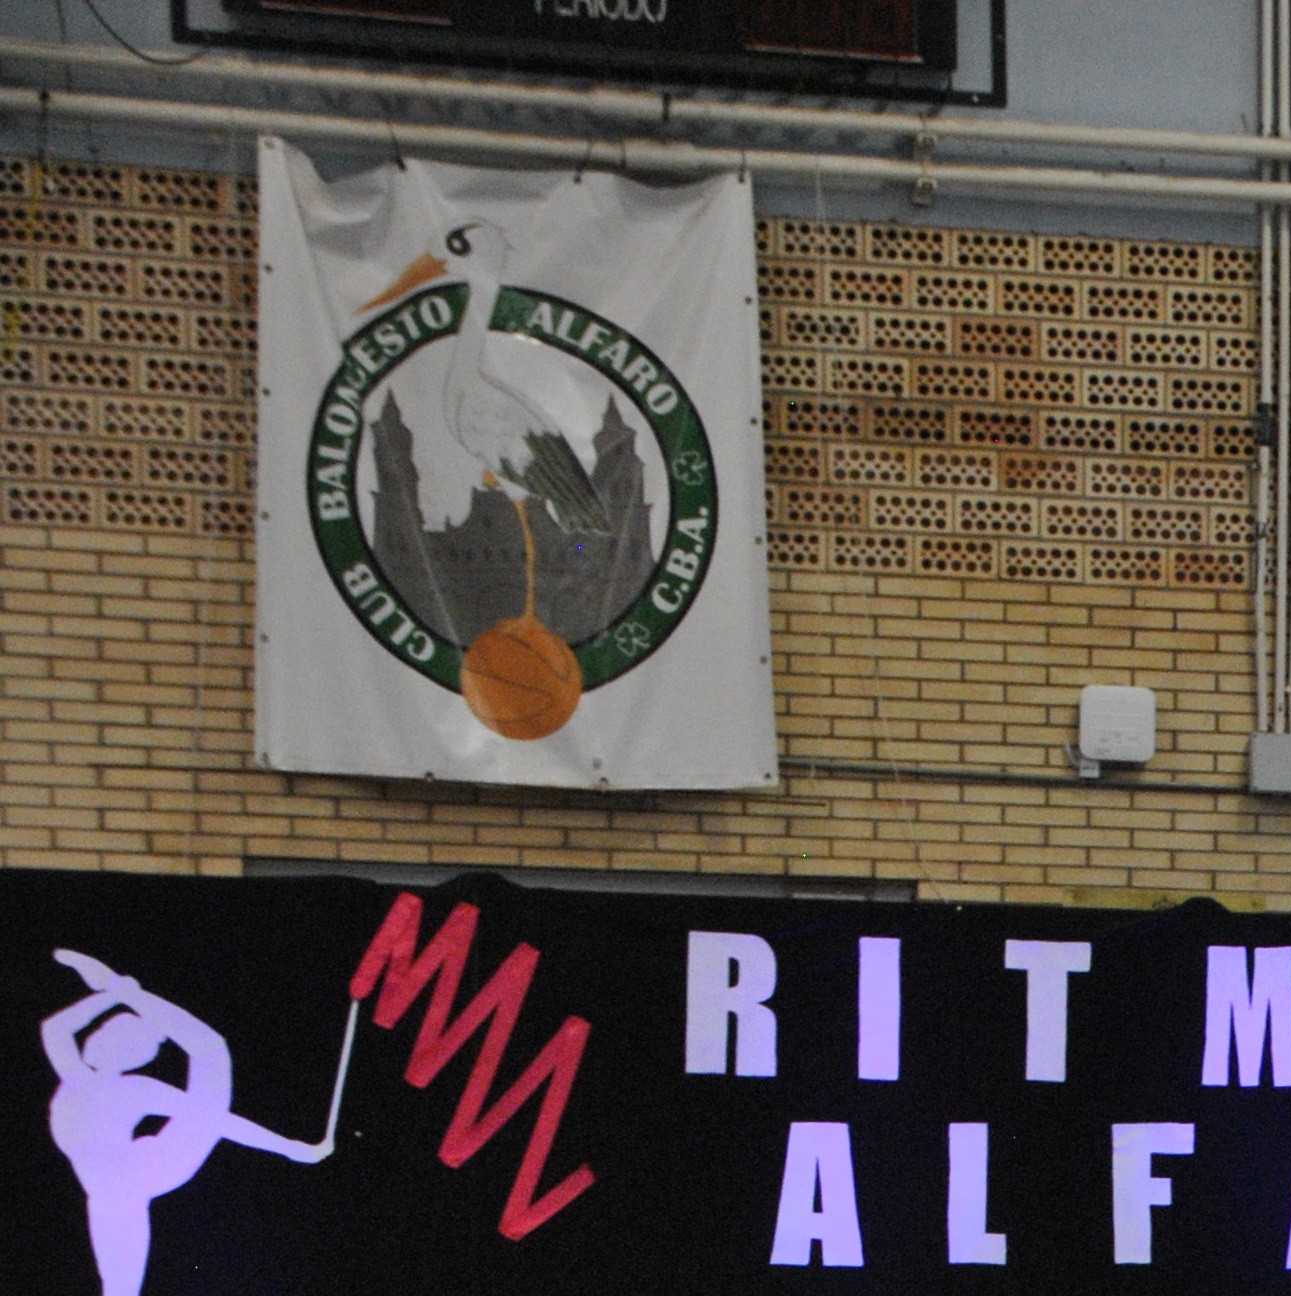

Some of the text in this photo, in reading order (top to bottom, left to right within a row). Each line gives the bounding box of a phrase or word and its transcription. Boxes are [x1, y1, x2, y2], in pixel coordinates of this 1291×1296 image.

[342, 562, 435, 661] CLUB
[527, 301, 678, 416] ALFARO
[651, 506, 709, 614] C.B.A.
